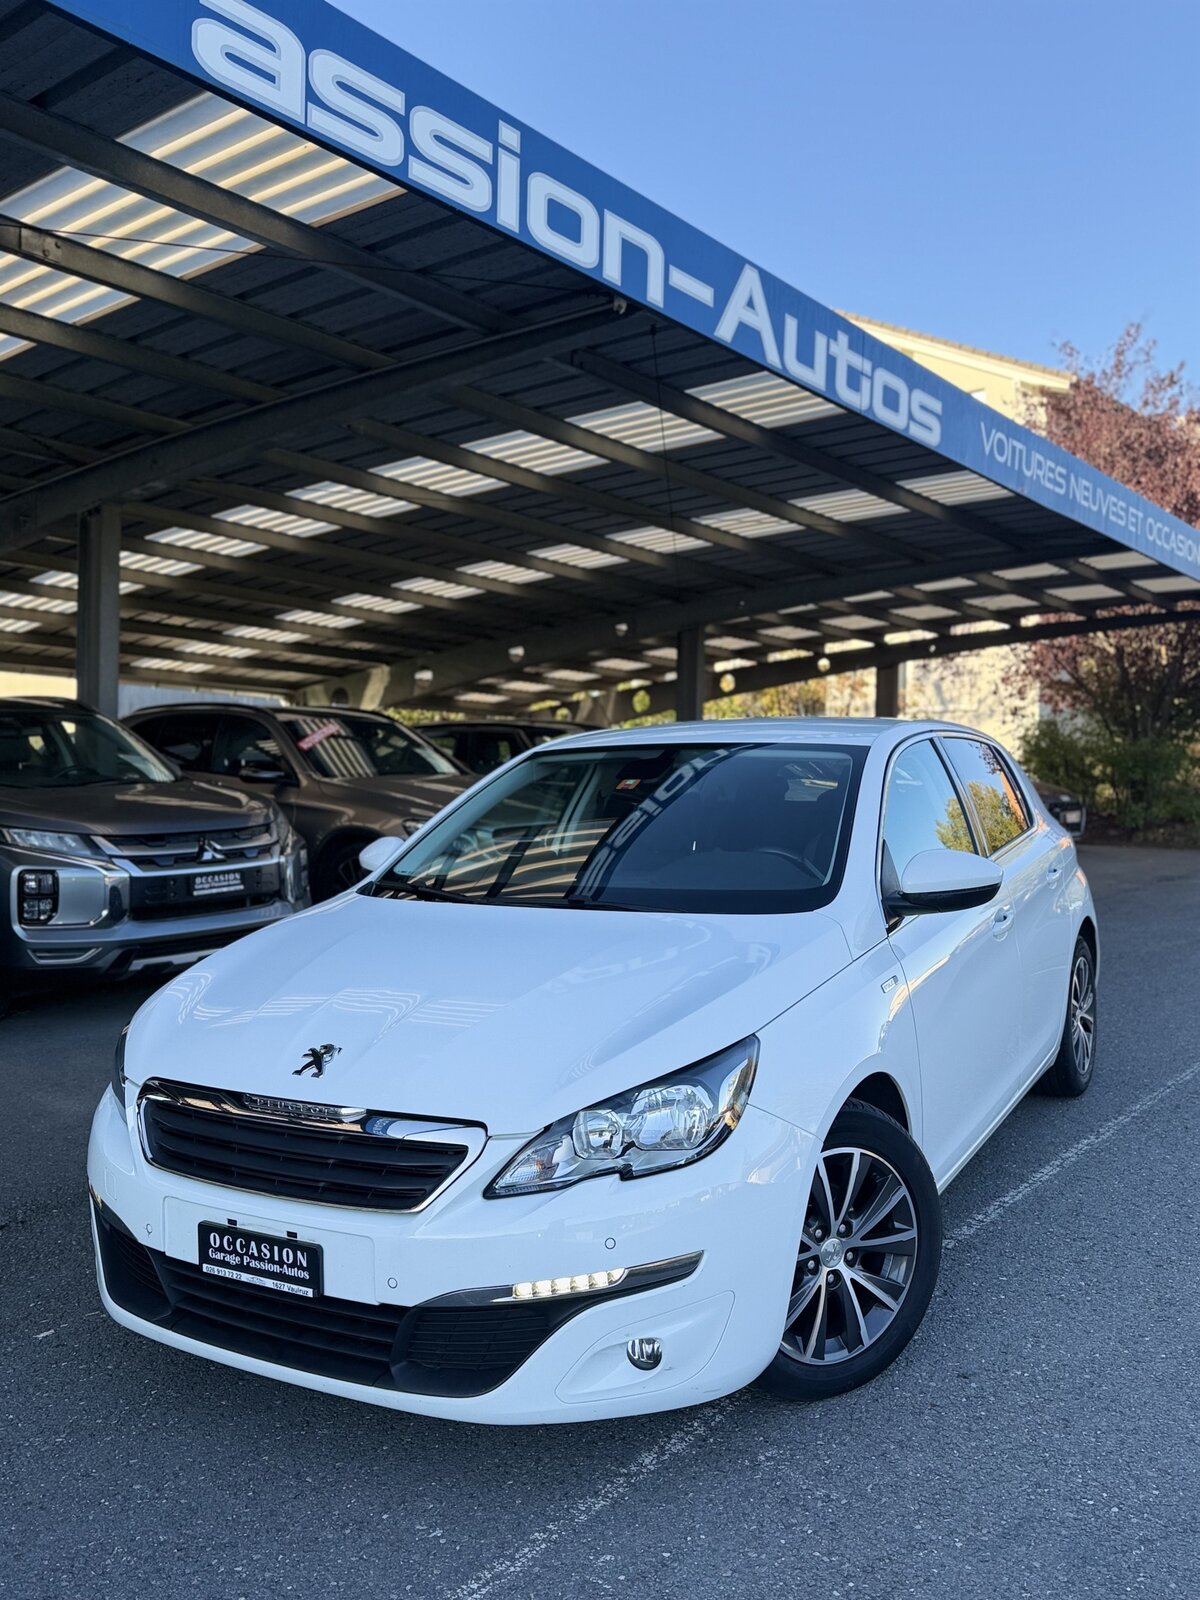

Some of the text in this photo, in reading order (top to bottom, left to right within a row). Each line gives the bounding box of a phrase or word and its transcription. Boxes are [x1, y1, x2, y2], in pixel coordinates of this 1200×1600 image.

[980, 421, 1067, 495] VOITURES
[1069, 473, 1126, 526] NEUVES
[1128, 506, 1143, 535] ET
[195, 872, 240, 884] OCCASION
[208, 1248, 310, 1280] Garage Passion-Autos
[209, 1232, 307, 1268] OCCASION
[216, 1268, 227, 1277] 913
[227, 1270, 235, 1278] 72
[235, 1272, 242, 1280] 22
[272, 1281, 286, 1291] 1627
[286, 1284, 309, 1296] Vaulruz
